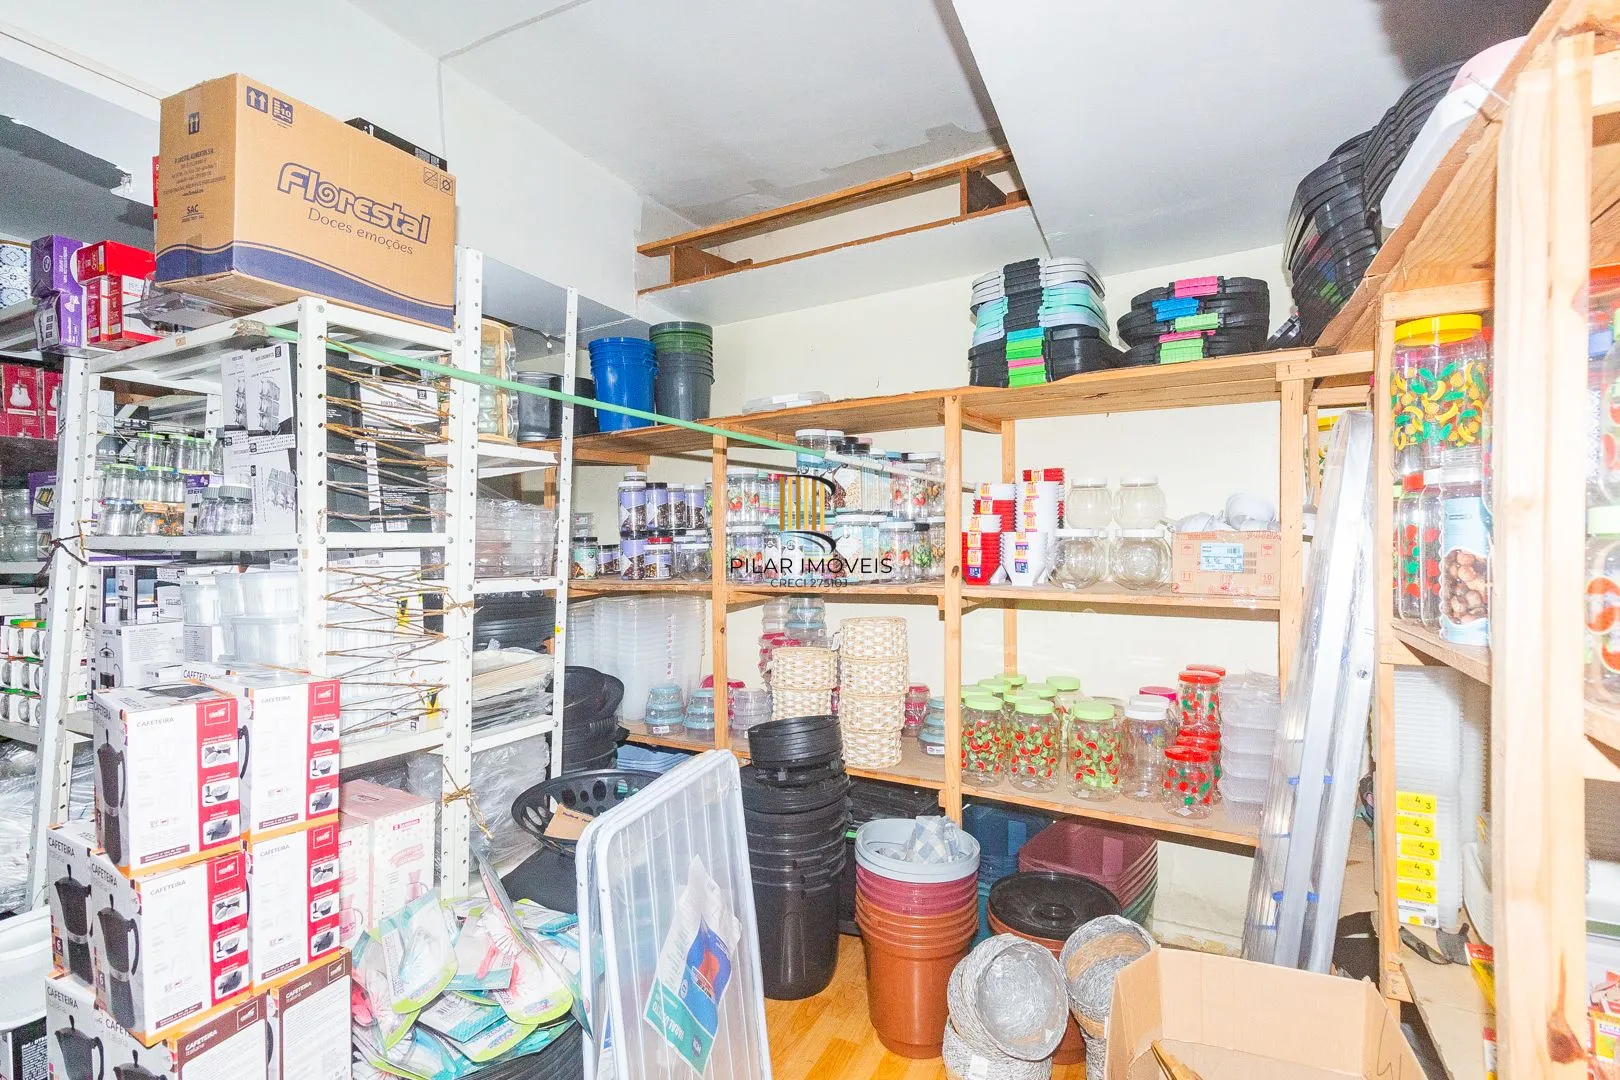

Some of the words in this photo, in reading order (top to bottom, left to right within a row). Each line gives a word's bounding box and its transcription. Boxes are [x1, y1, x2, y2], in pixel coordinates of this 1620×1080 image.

[187, 204, 199, 214] SAC
[277, 162, 431, 244] Florestal
[308, 207, 352, 233] Doces
[357, 228, 413, 254] emoções
[136, 717, 174, 727] CAFETEIRA
[48, 837, 75, 858] CAFETEIRA
[260, 844, 290, 857] CAFETEIRA
[92, 863, 117, 887] CAFETEIRA
[150, 880, 186, 896] CAFETEIRA
[46, 986, 78, 1009] CAFETEIRA
[285, 981, 313, 999] CAFETEIRA
[185, 1029, 218, 1051] CAFETEIRA
